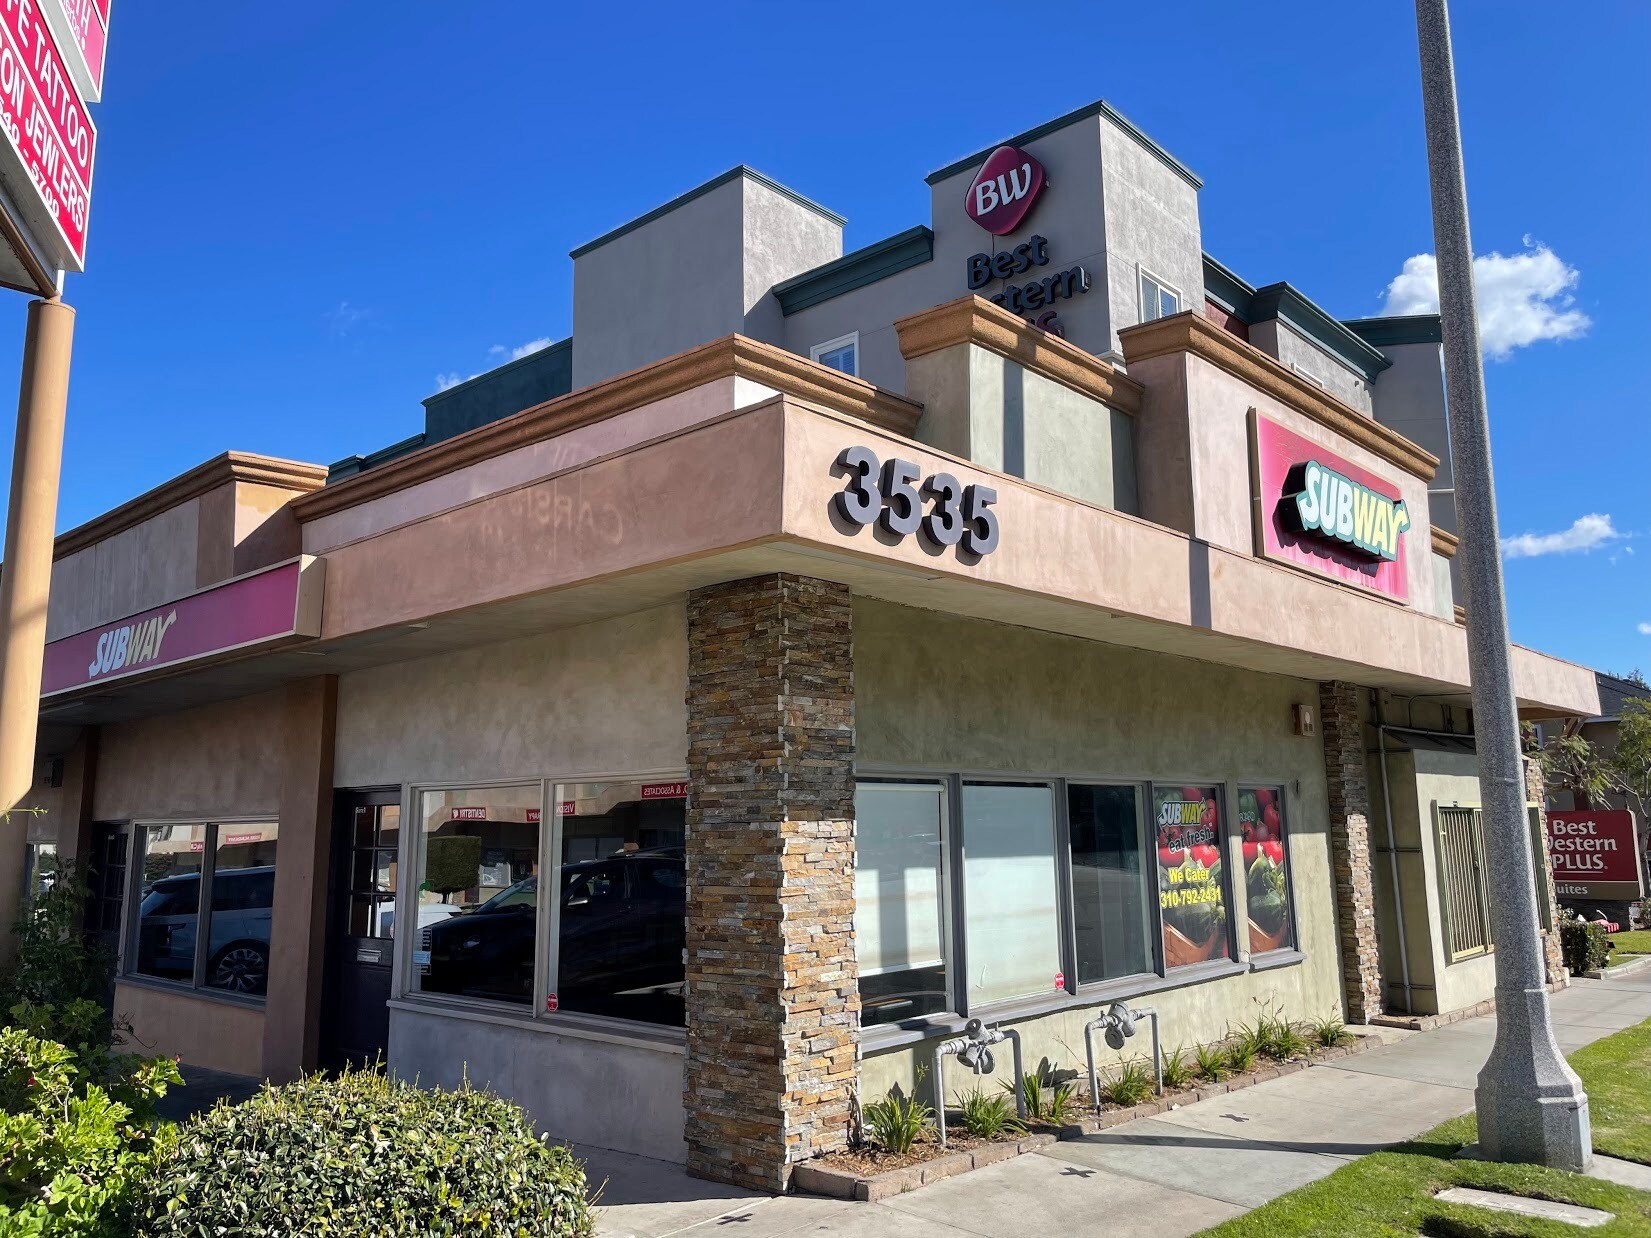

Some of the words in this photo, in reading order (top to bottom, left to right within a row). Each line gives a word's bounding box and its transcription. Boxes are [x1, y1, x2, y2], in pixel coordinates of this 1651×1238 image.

[34, 22, 88, 168] TATTOO
[0, 32, 25, 118] ON
[25, 101, 85, 232] JEWLERS
[975, 162, 1031, 216] BW
[966, 234, 1050, 290] Best
[838, 445, 1000, 556] 3535
[1297, 463, 1409, 557] SUBWAY
[88, 609, 177, 679] SUBWAY
[1157, 797, 1207, 830] SUBWAY
[1552, 819, 1597, 835] Best
[1168, 835, 1186, 854] eat
[1552, 854, 1604, 870] PLUS
[1168, 866, 1184, 884] We
[1185, 866, 1210, 883] Cater
[1556, 884, 1588, 895] uites
[1160, 885, 1221, 909] 310-792-2431
